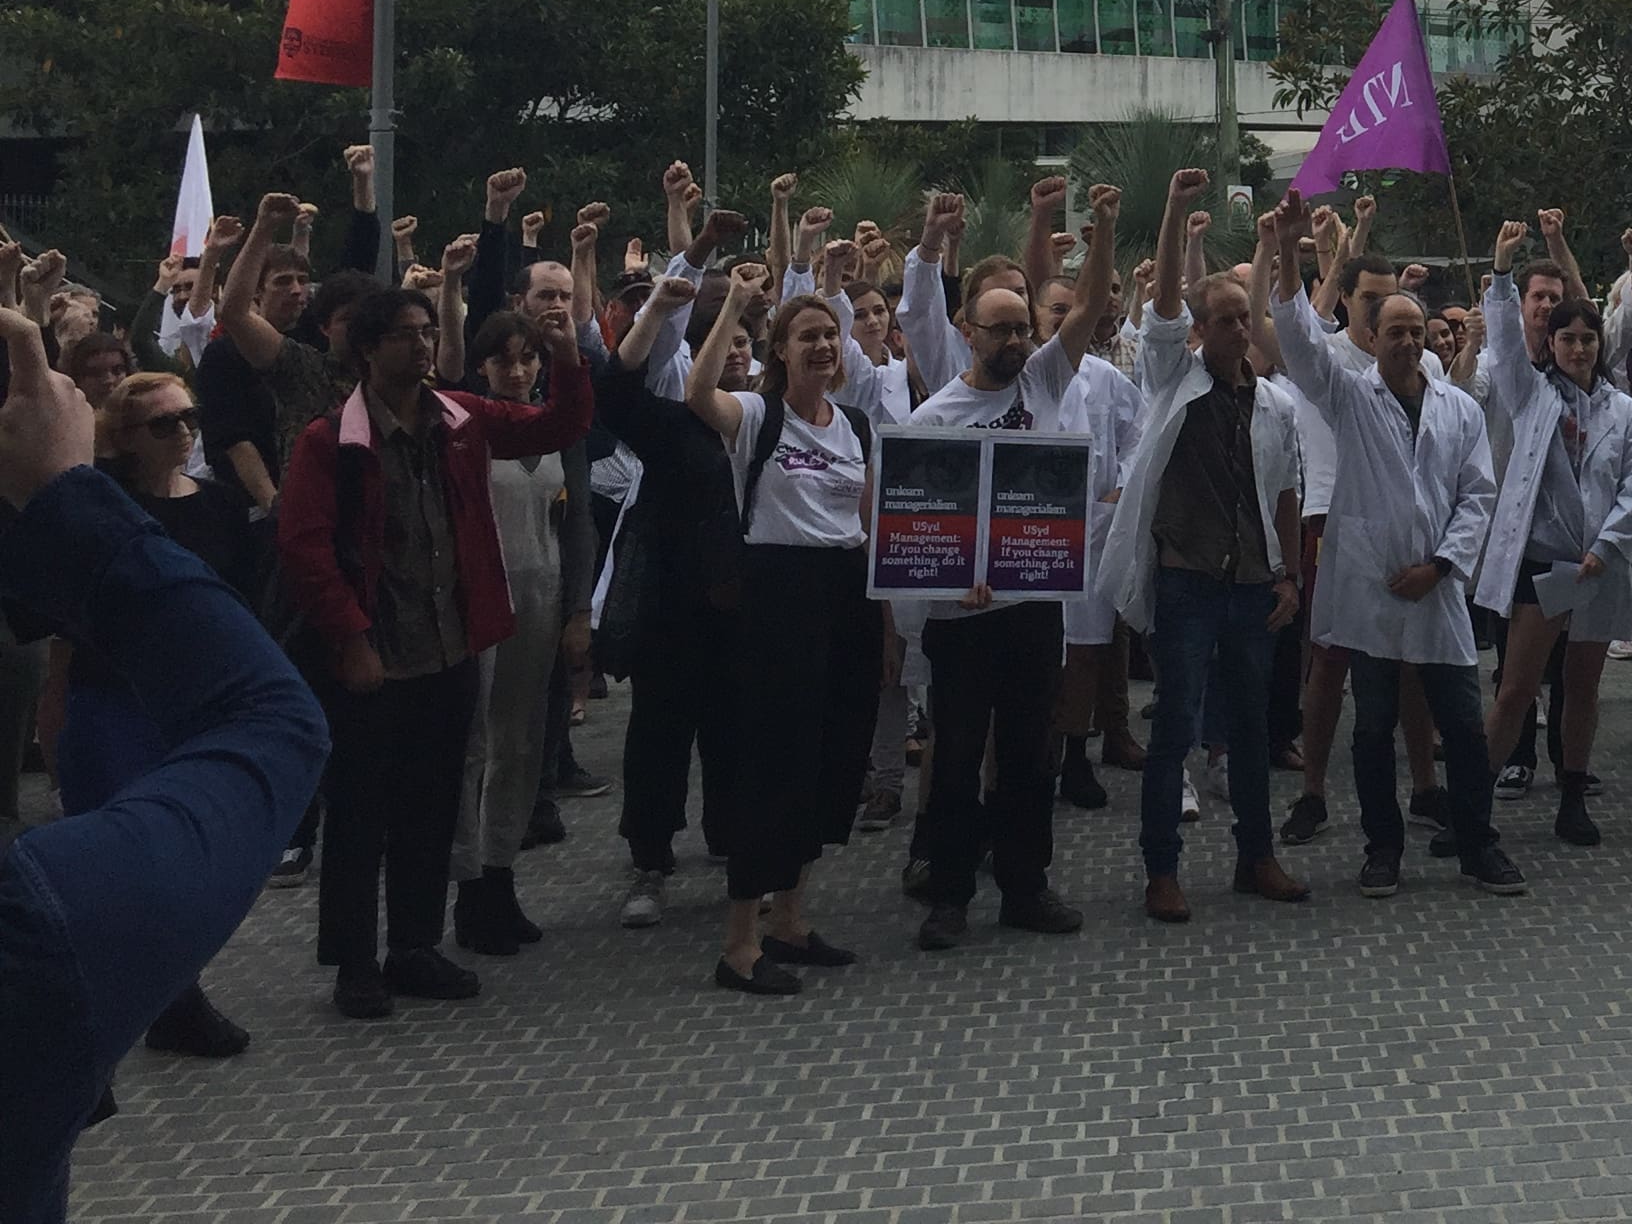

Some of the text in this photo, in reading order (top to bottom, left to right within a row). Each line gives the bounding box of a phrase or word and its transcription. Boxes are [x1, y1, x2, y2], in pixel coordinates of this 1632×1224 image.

[885, 485, 925, 497] unlearn
[996, 489, 1035, 501] unlearn
[912, 521, 941, 534] USyd
[1022, 524, 1050, 537] USyd
[889, 532, 961, 545] Management:
[1001, 535, 1070, 548] Management:
[889, 544, 960, 556] If you change
[1001, 547, 1069, 559] If you change
[942, 556, 955, 566] do
[956, 556, 966, 566] it
[1052, 558, 1064, 568] do
[1066, 558, 1074, 569] it
[908, 566, 938, 579] right!
[1019, 569, 1049, 582] right!
